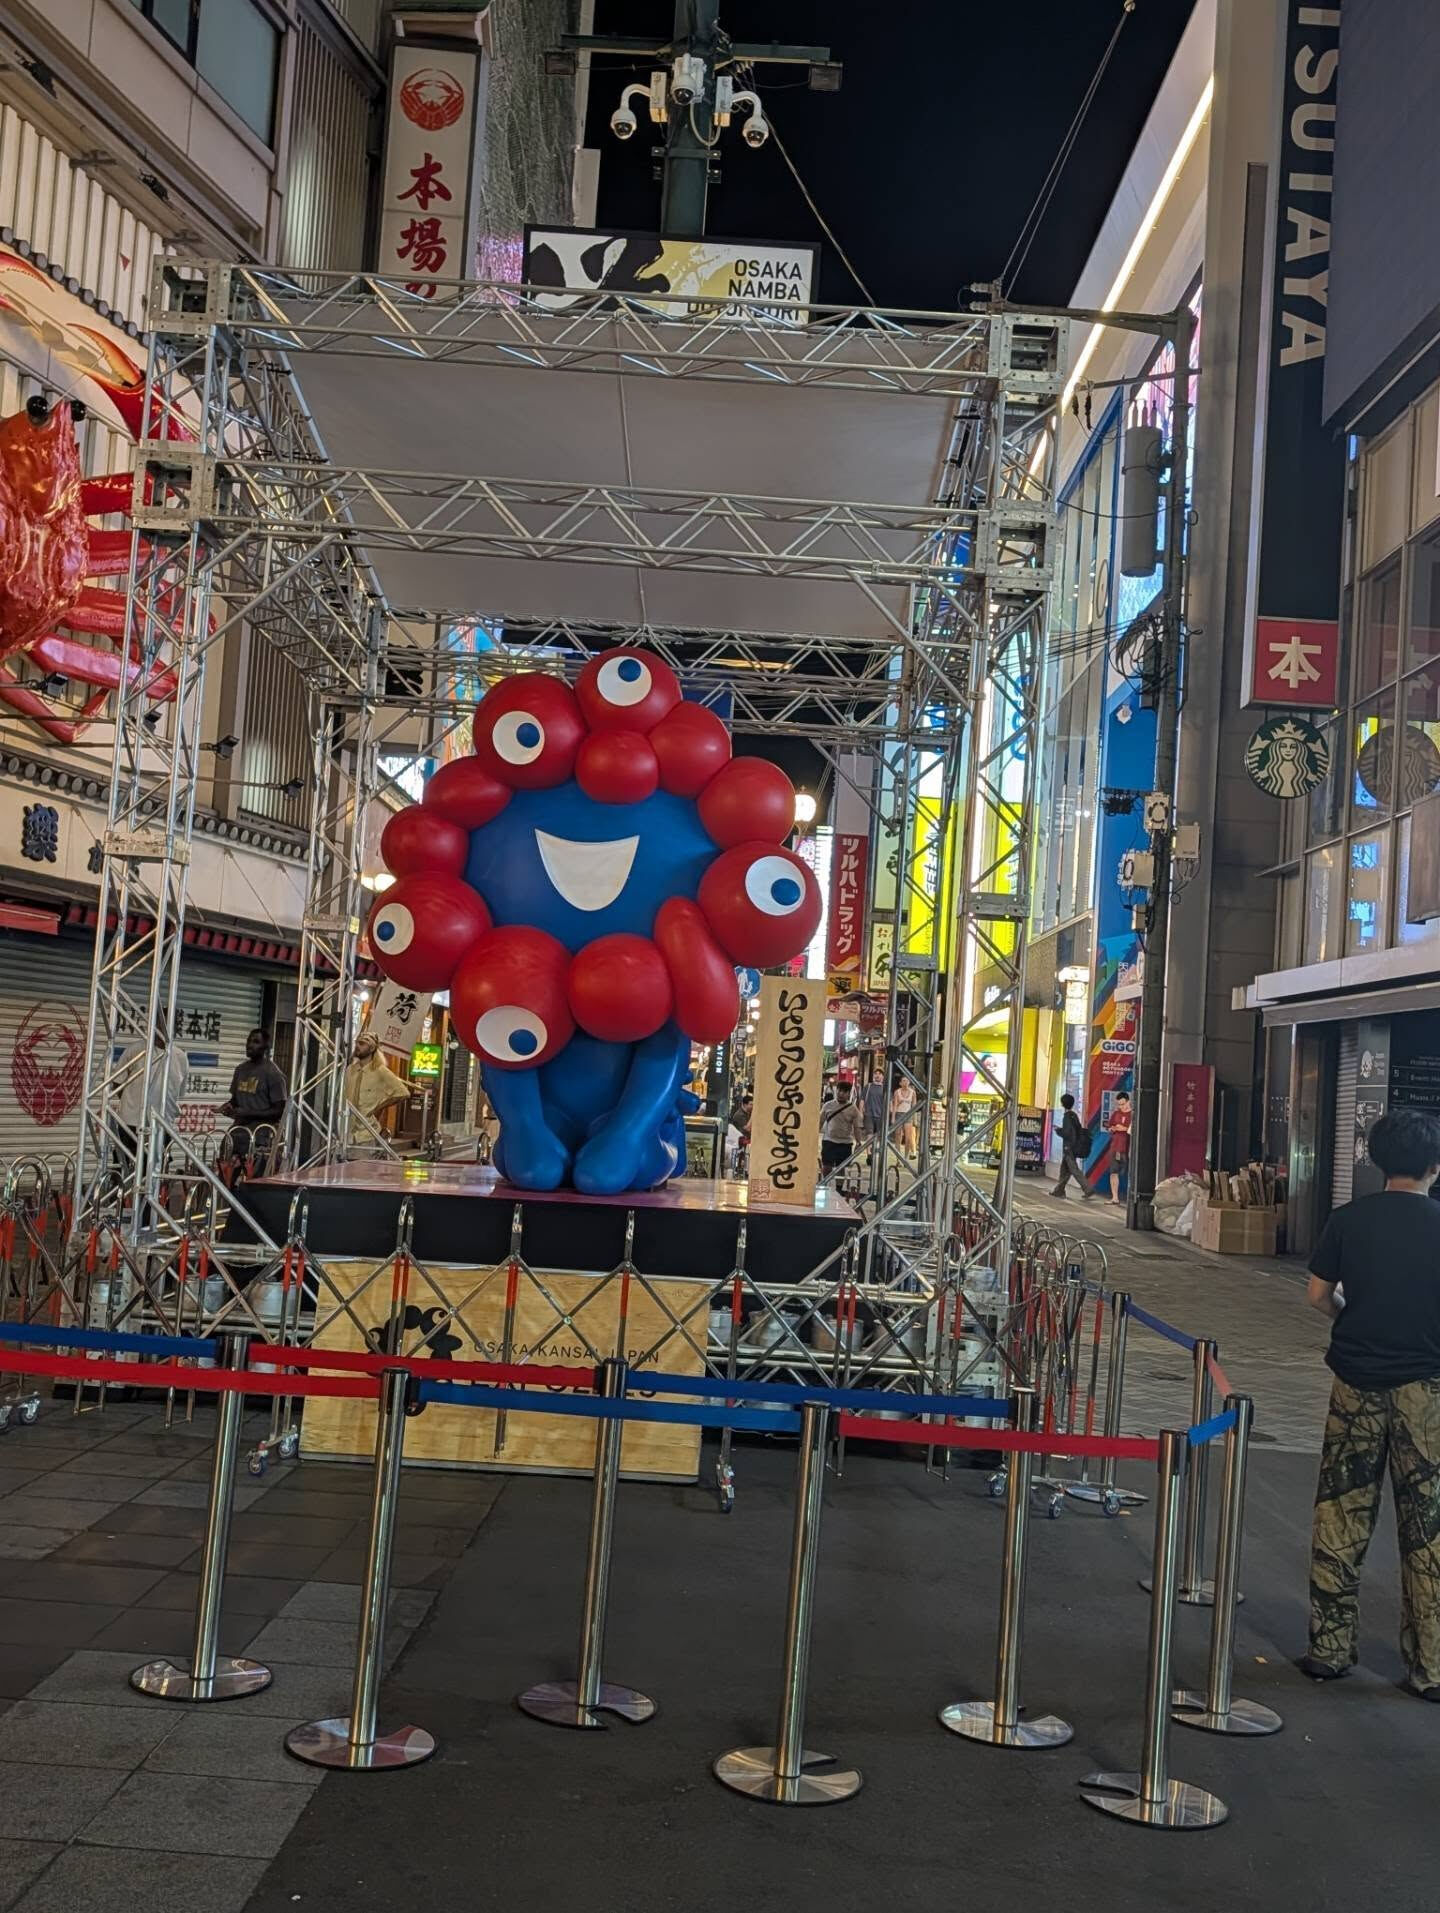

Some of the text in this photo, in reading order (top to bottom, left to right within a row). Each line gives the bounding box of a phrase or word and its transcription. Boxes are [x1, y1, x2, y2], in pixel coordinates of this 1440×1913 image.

[734, 258, 803, 281] OSAKA
[727, 278, 802, 301] NAMBA
[1268, 636, 1322, 689] 本
[835, 838, 860, 954] ツルハドラッグ
[611, 1348, 660, 1363] JPAN
